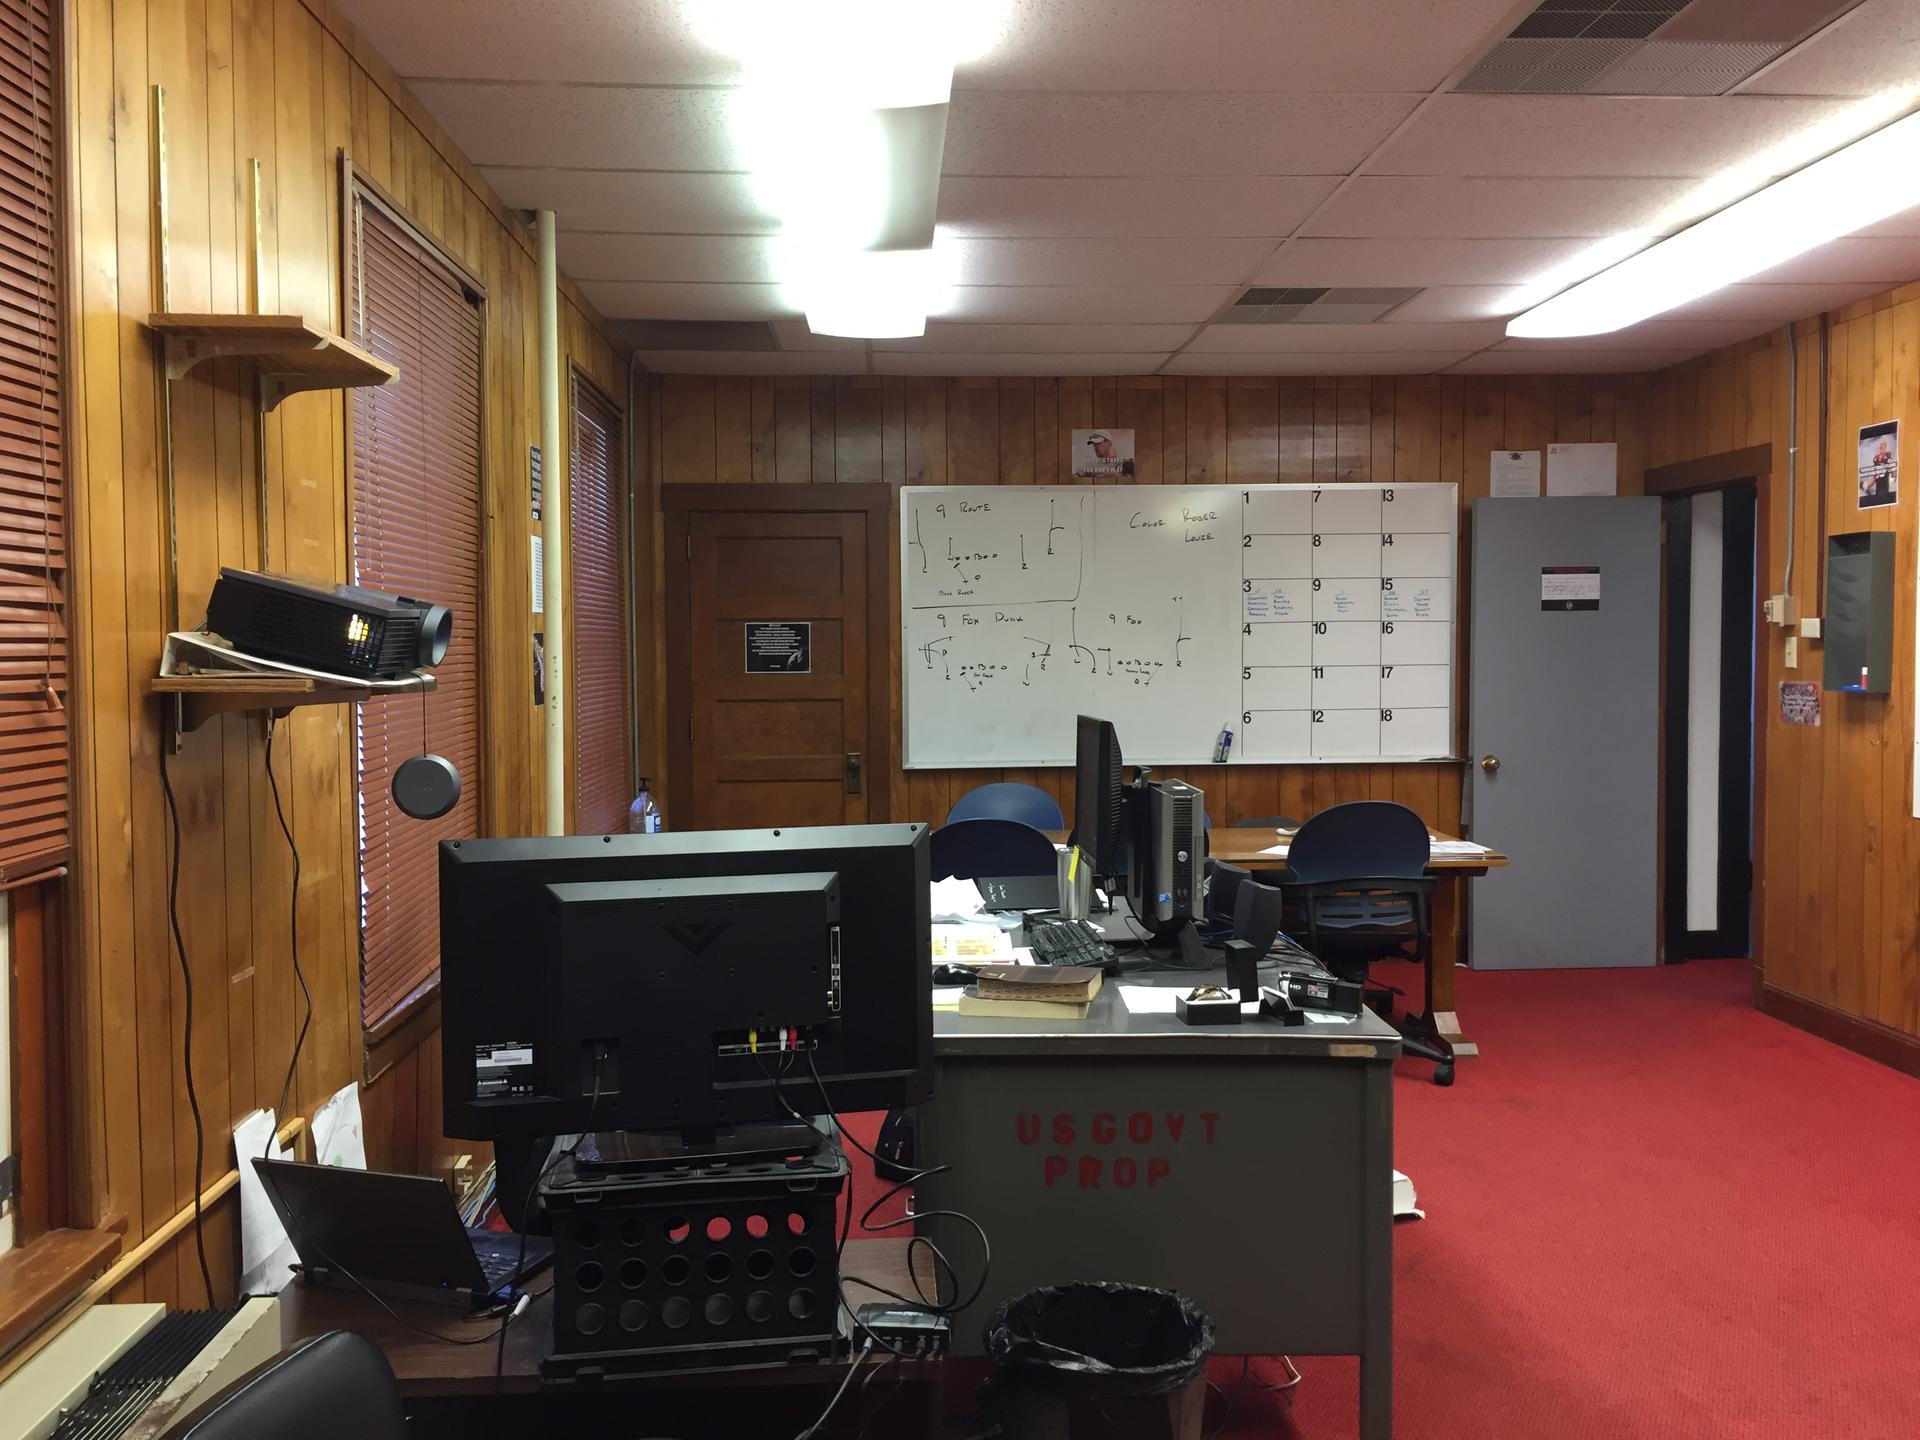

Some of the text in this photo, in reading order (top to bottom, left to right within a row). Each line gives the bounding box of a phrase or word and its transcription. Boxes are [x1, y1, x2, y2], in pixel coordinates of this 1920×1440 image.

[1243, 491, 1250, 503] 1
[1312, 491, 1322, 503] 7
[1382, 490, 1394, 502] 13
[1243, 535, 1252, 548] 2
[1312, 535, 1322, 547] 8
[1382, 534, 1394, 547] 14
[1243, 580, 1252, 593] 3
[1312, 578, 1322, 592] 9
[1382, 578, 1393, 591] 15
[1243, 623, 1252, 635] 4
[1313, 623, 1327, 635] 10
[1382, 622, 1394, 634] 16
[1243, 667, 1252, 680] 5
[1313, 667, 1324, 679] 11
[1382, 667, 1394, 679] 17
[1243, 711, 1252, 724] 6
[1312, 711, 1324, 723] 12
[1381, 710, 1393, 722] 18
[1043, 1154, 1171, 1189] PROP
